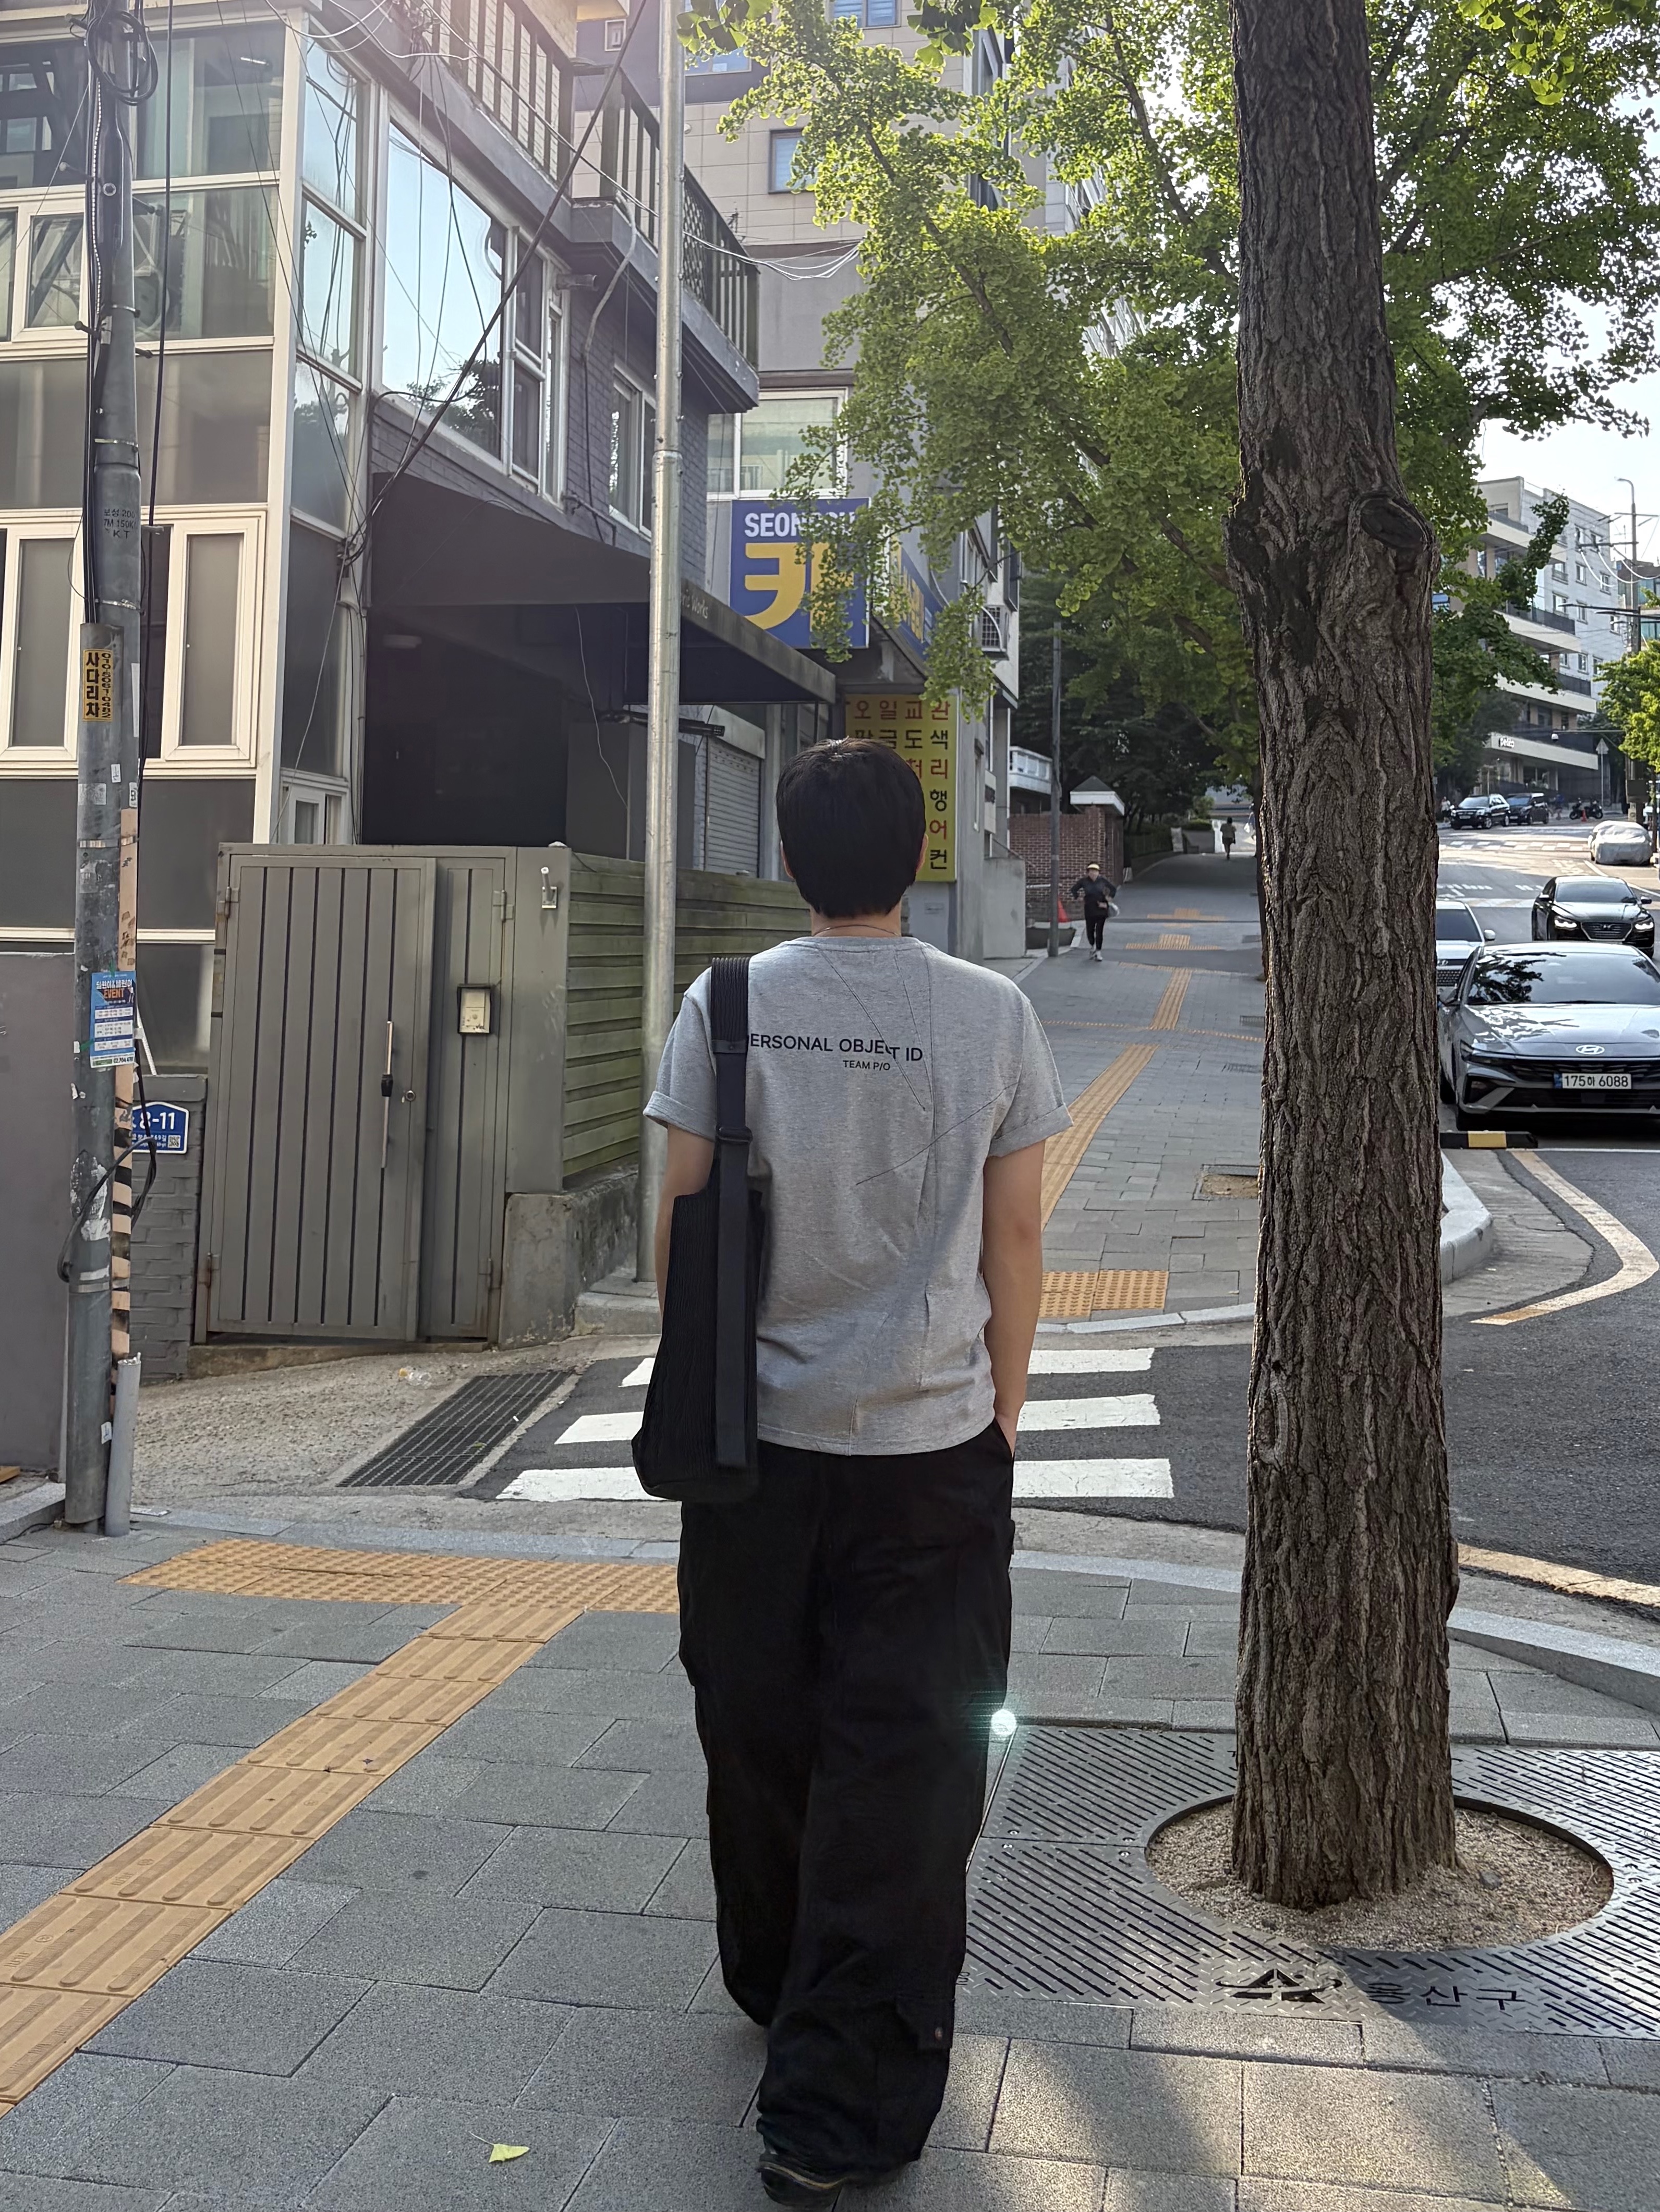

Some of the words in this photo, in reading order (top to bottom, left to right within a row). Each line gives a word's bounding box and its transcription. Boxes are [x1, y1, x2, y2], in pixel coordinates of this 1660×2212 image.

[86, 652, 100, 718] 사다리차
[104, 988, 125, 999] EVENT
[747, 1034, 833, 1052] ERSONAL
[906, 1048, 923, 1062] ID
[843, 1060, 870, 1069] TEAM
[873, 1062, 891, 1071] P/O
[1598, 1076, 1628, 1087] 6088
[1362, 1983, 1525, 2011] 용산구
